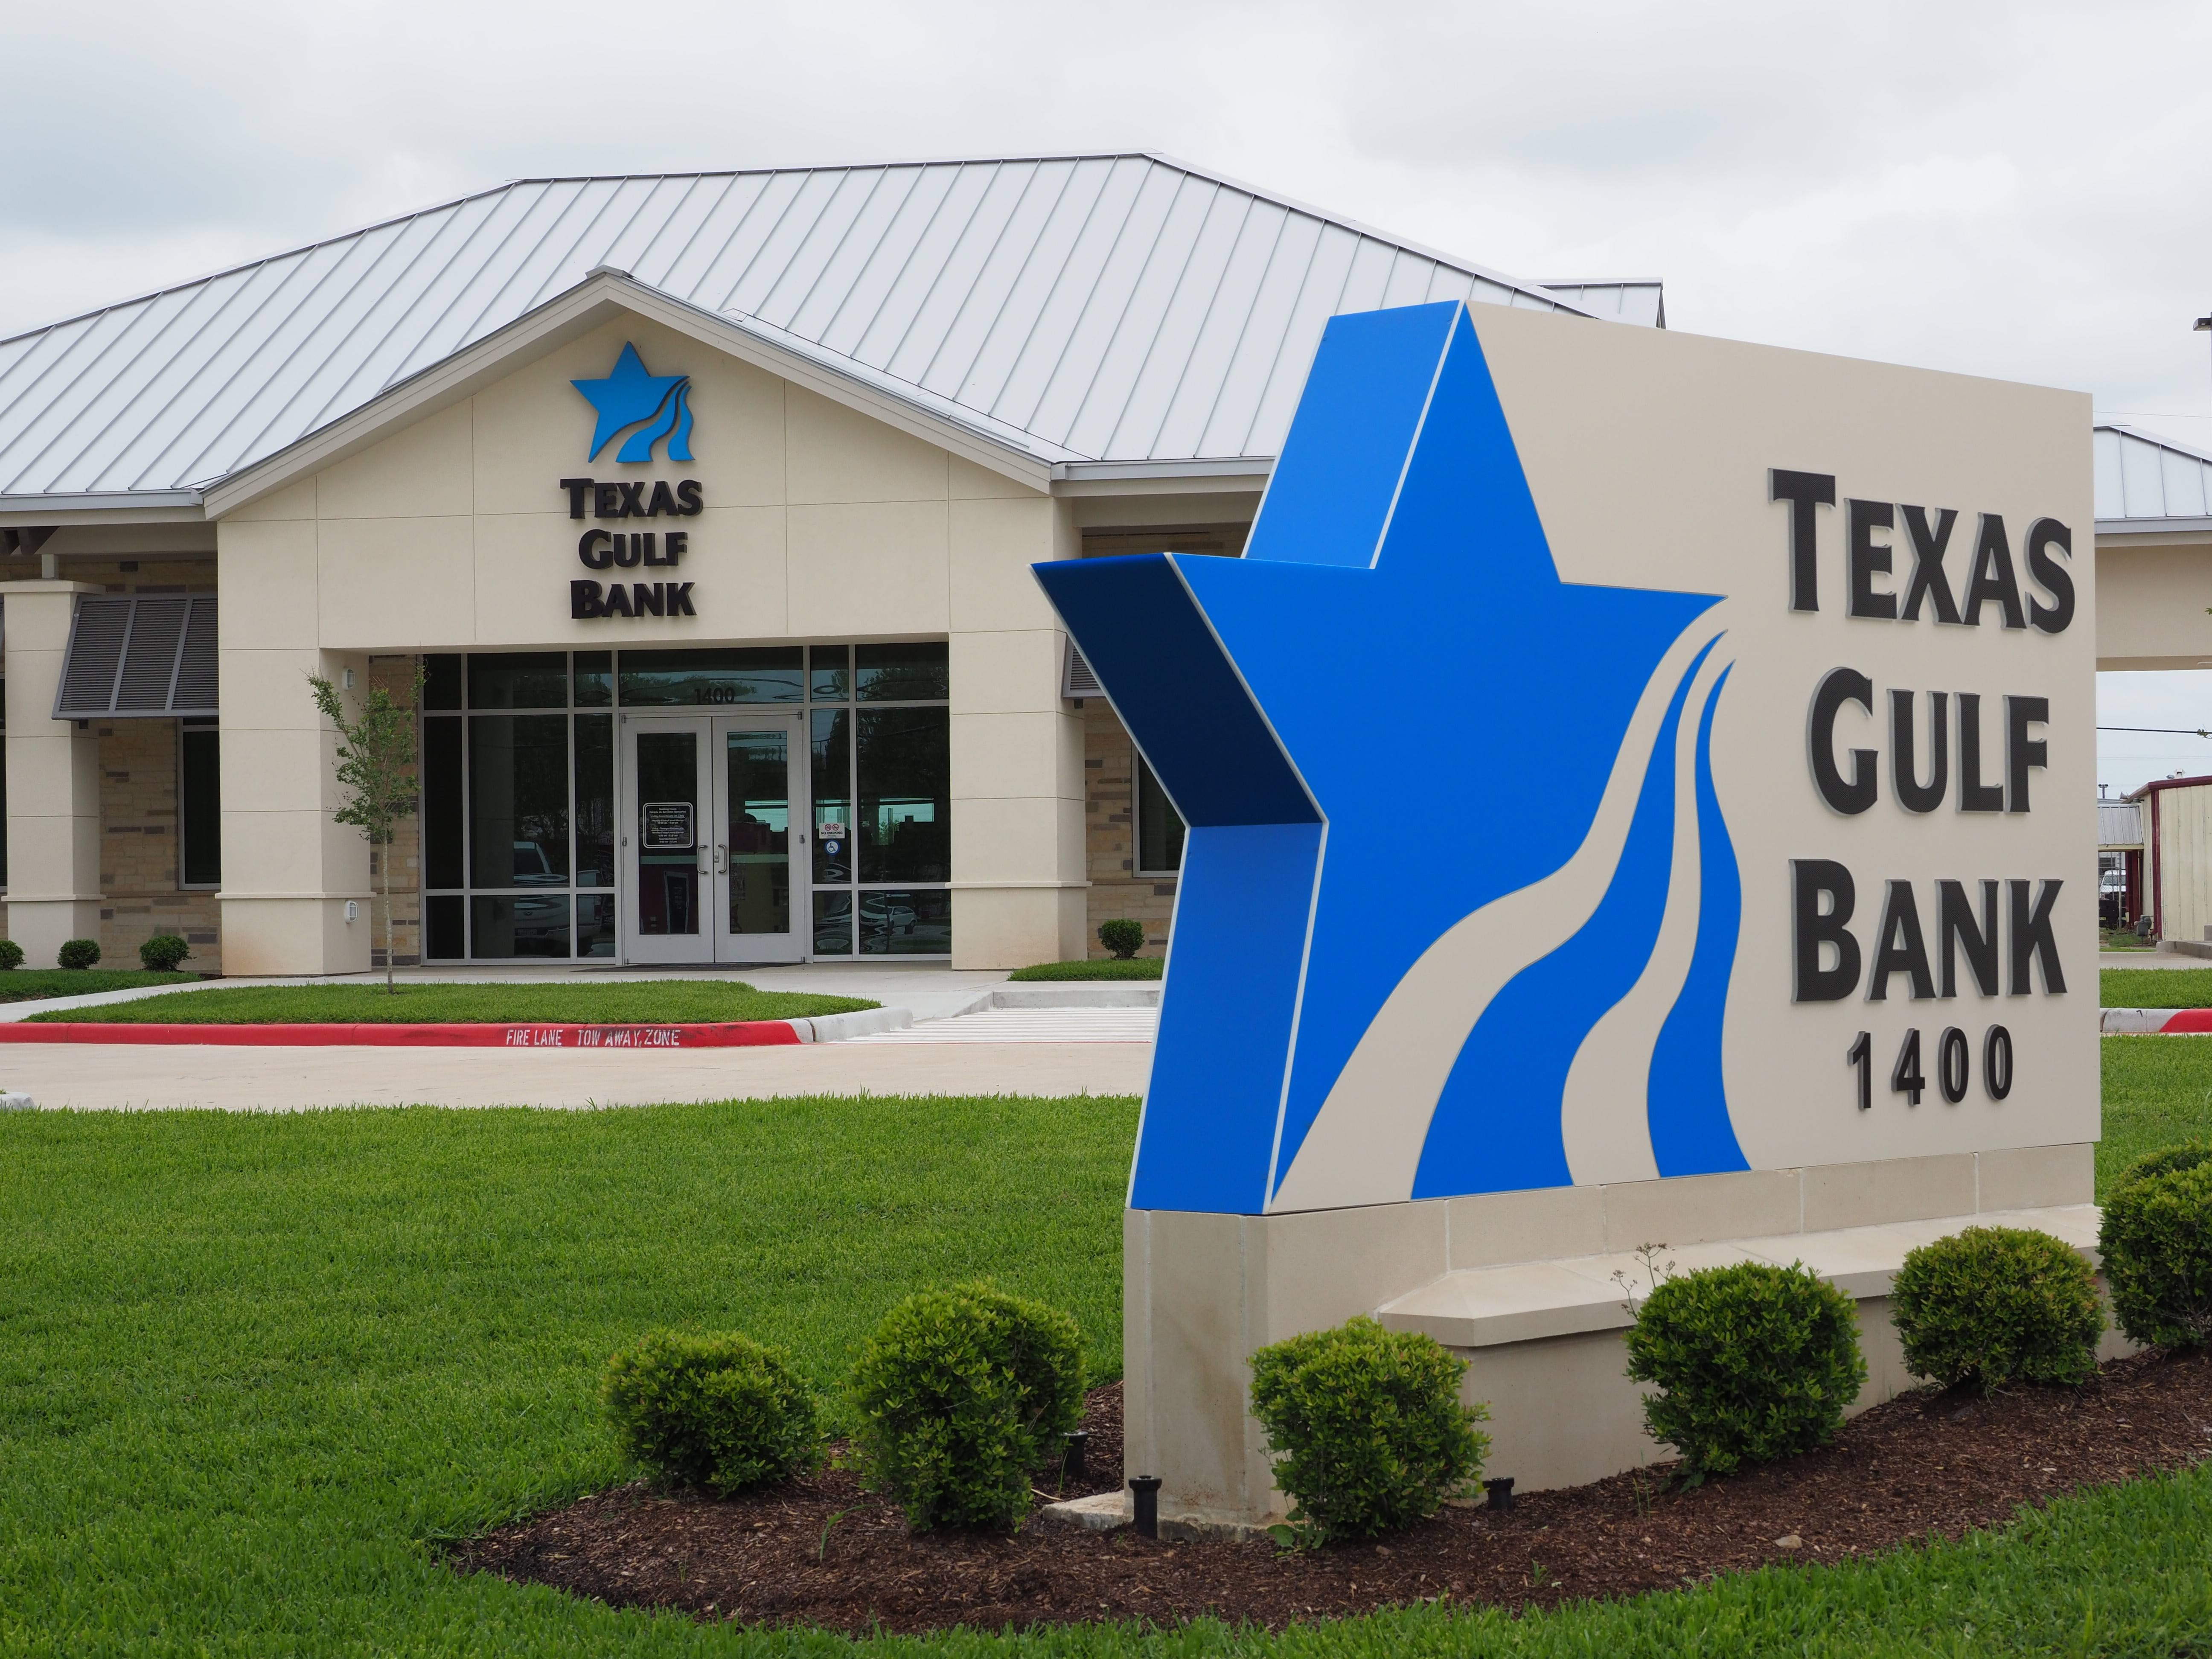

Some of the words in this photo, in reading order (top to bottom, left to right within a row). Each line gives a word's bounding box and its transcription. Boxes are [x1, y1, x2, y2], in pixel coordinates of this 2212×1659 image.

[560, 478, 703, 519] TEXAS
[579, 529, 688, 569] GULF
[1767, 468, 2075, 634] TEXAS
[570, 580, 697, 619] BANK
[695, 687, 735, 704] 1400
[1806, 667, 2049, 816] GULF
[1788, 859, 2067, 1004] BANK
[506, 1029, 530, 1045] FIRE
[534, 1029, 563, 1045] LANE
[578, 1030, 600, 1045] TOW
[644, 1030, 681, 1045] ZONE
[1847, 1024, 2014, 1109] 1400
